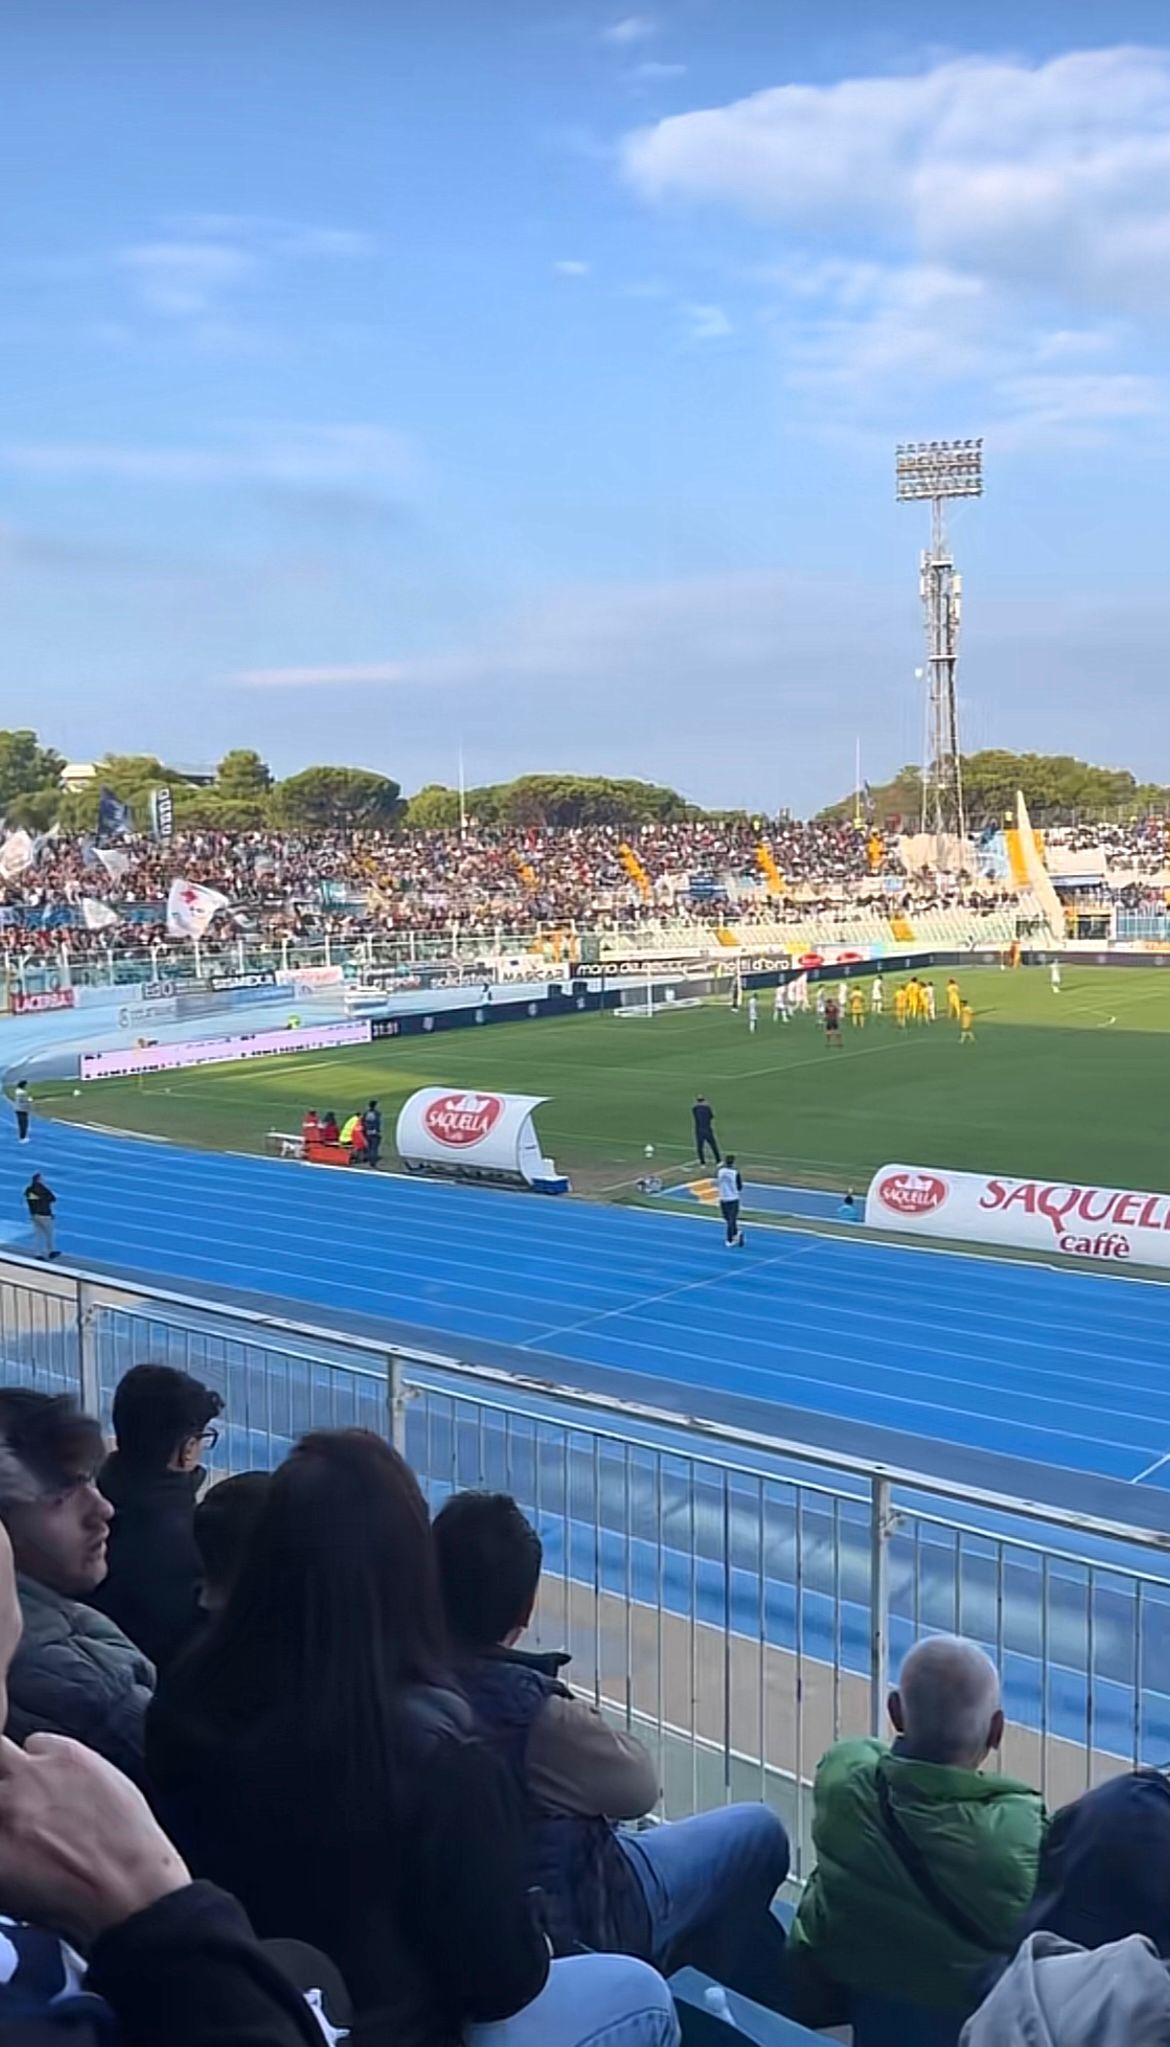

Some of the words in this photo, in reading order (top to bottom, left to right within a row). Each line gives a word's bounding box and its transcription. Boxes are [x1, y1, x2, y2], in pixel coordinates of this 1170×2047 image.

[427, 1110, 489, 1133] SAQUELLA
[882, 1187, 938, 1206] SAQUELLA
[1060, 1232, 1130, 1258] caffè
